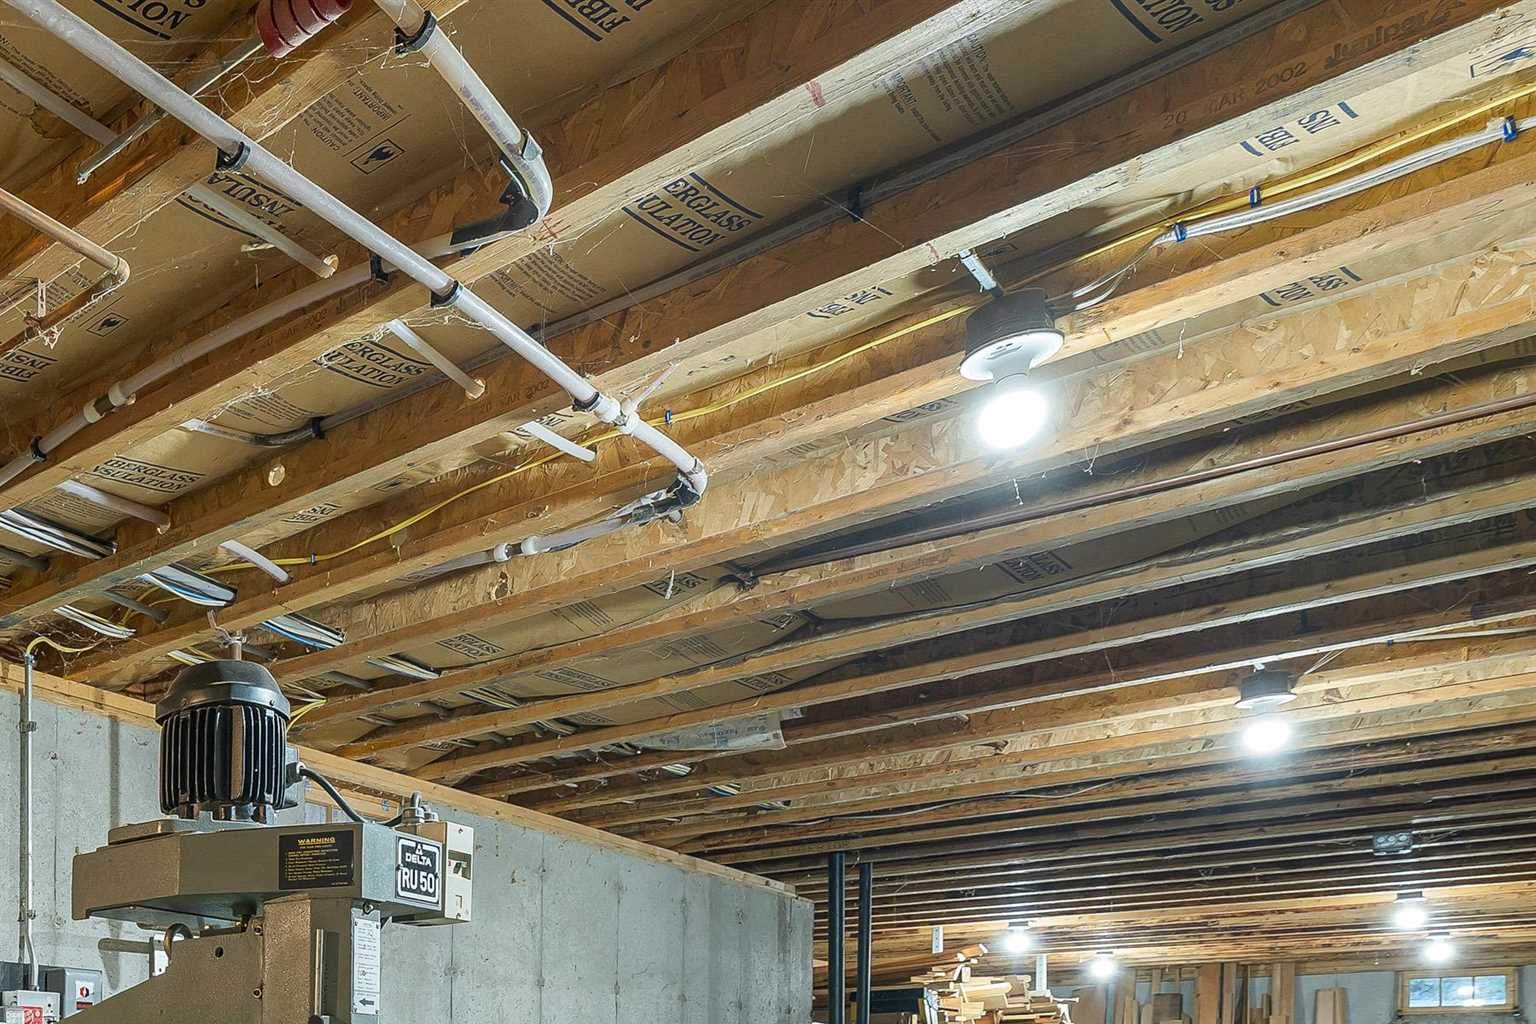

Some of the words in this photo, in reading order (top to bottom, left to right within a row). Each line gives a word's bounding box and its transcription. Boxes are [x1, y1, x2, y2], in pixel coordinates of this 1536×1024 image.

[1255, 60, 1308, 96] 2002
[297, 836, 336, 845] WARNING
[405, 852, 432, 867] DELTA
[402, 866, 418, 890] RU
[420, 871, 435, 893] 50
